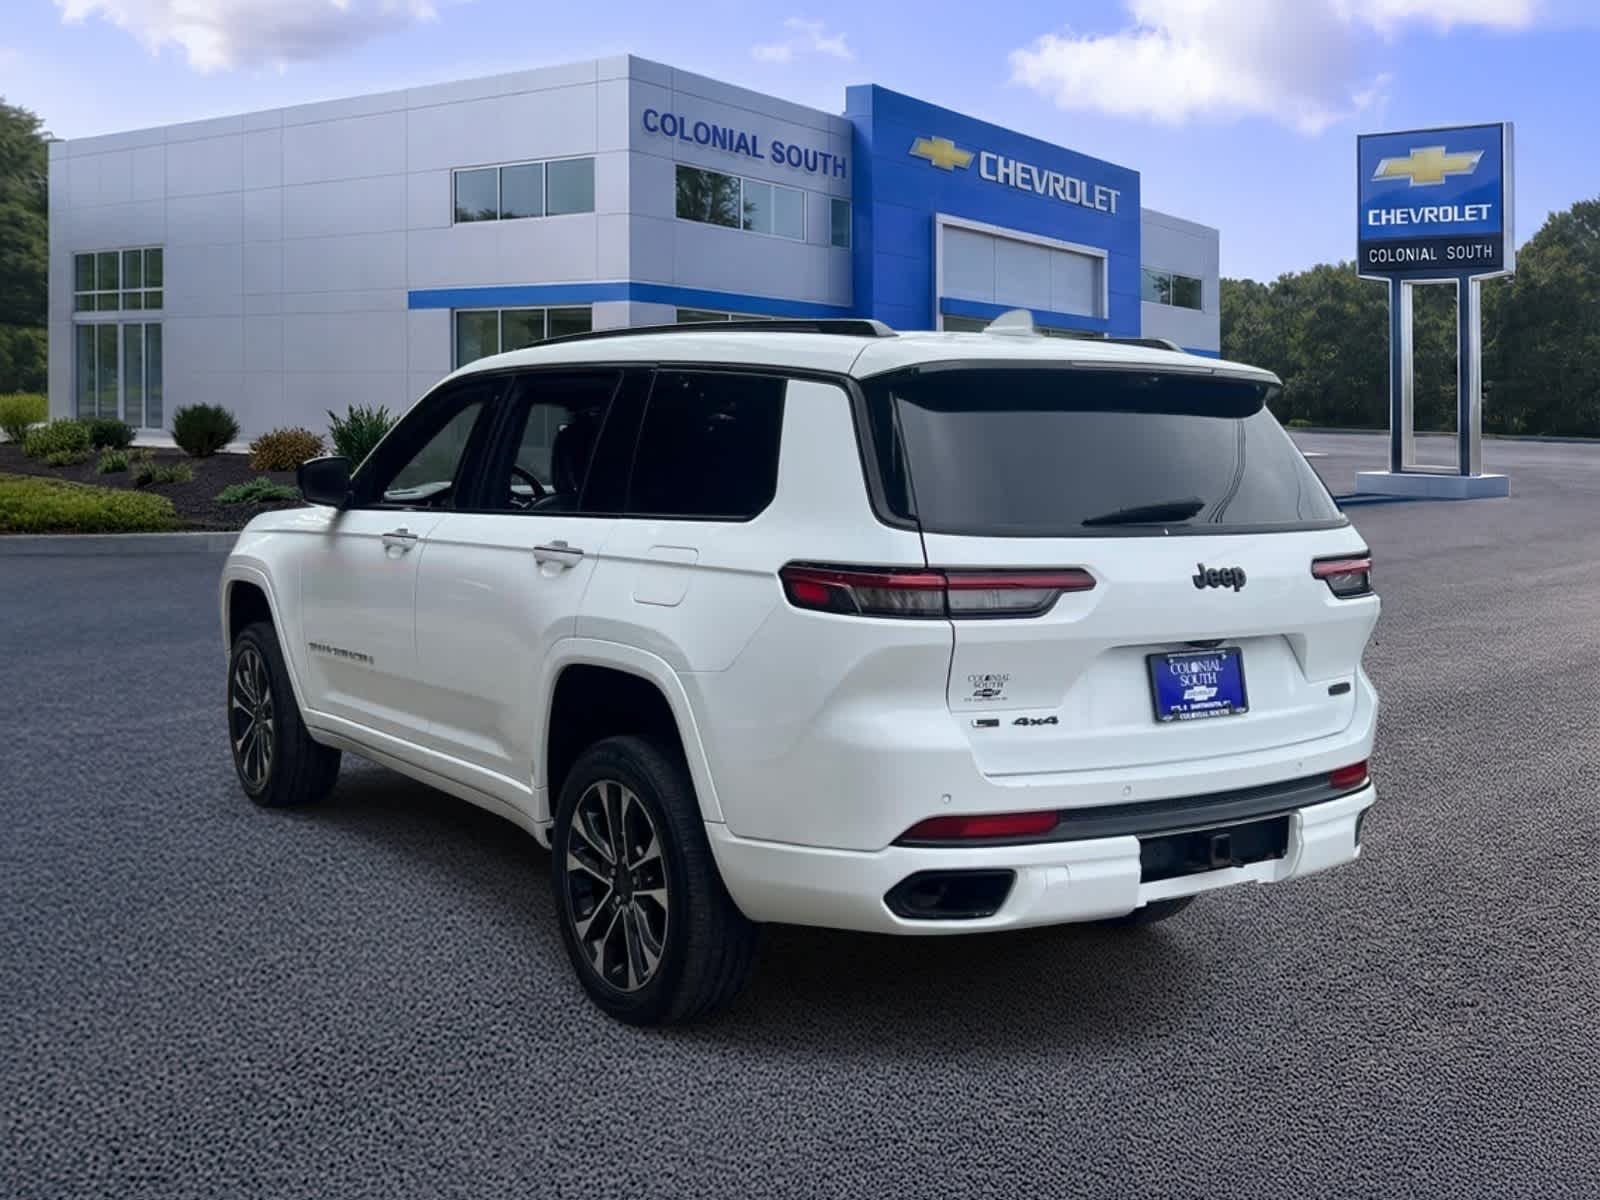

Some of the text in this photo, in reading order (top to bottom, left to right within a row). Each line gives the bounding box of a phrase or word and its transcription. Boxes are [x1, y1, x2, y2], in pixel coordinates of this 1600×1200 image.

[643, 108, 848, 179] COLONIAL SOUTH
[979, 151, 1121, 214] CHEVROLET
[1368, 203, 1492, 226] CHEVROLET
[1369, 244, 1493, 263] COLONIAL SOUTH
[1191, 562, 1247, 592] Jeep
[1180, 672, 1217, 687] SOUTH
[1012, 716, 1059, 726] 4x4
